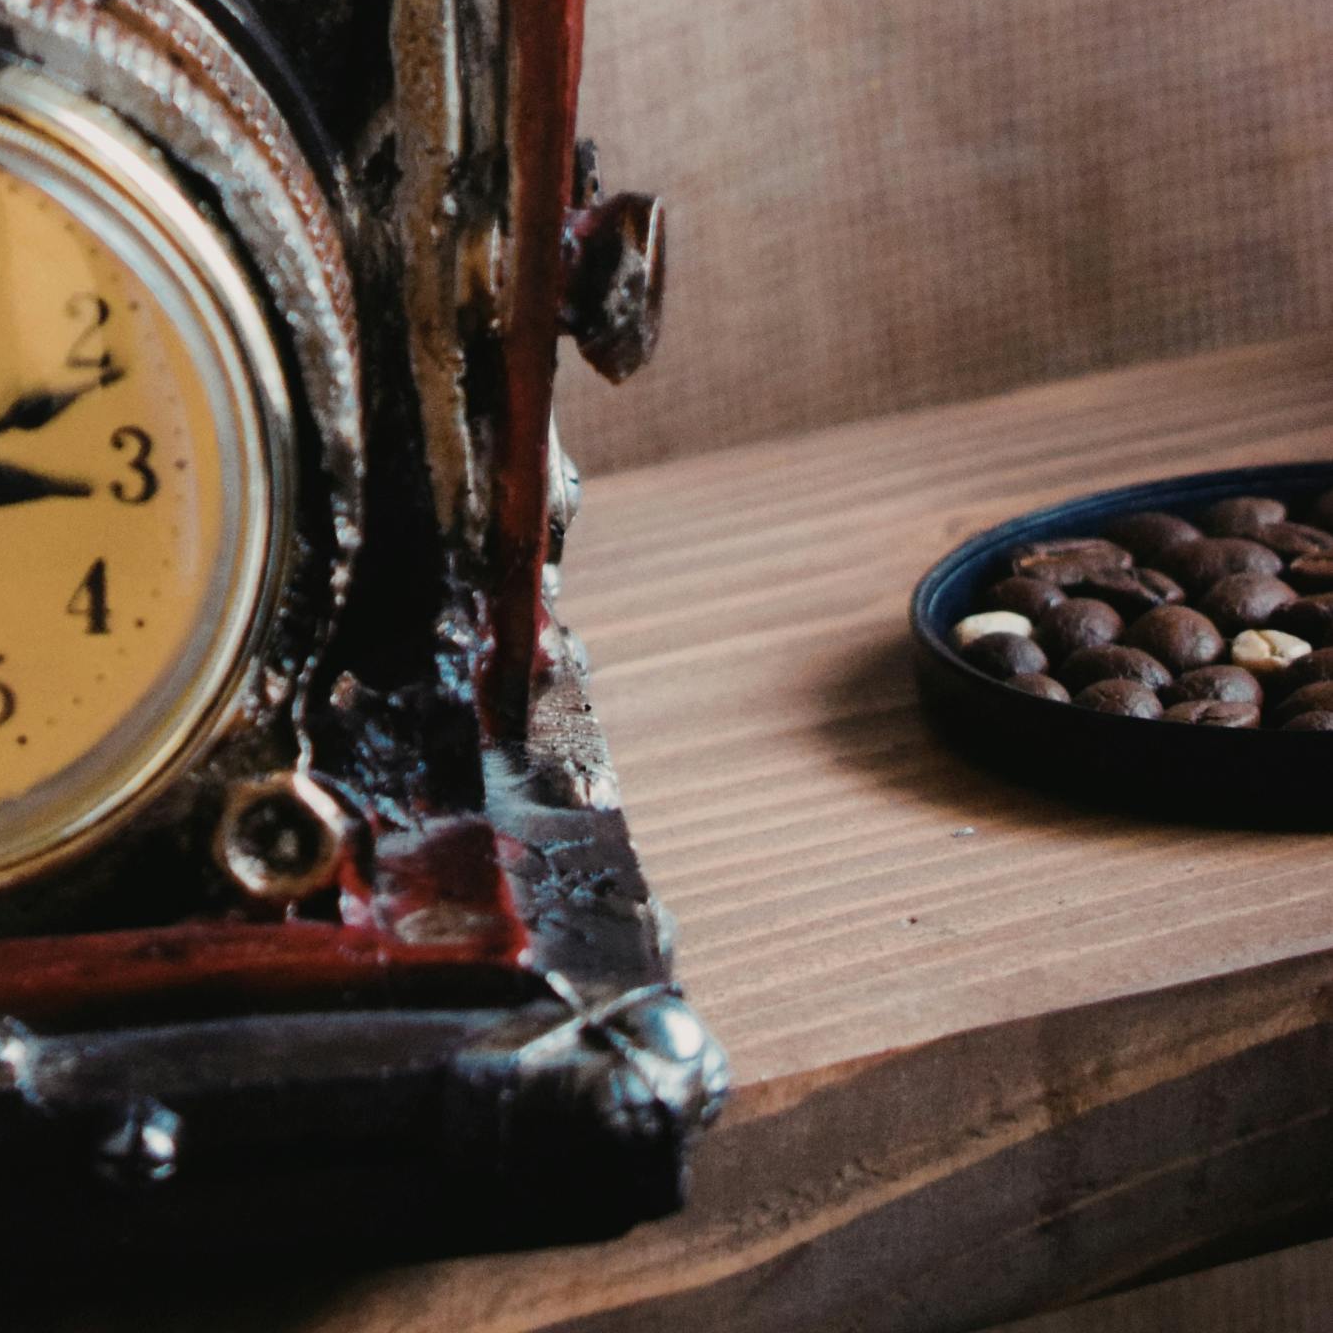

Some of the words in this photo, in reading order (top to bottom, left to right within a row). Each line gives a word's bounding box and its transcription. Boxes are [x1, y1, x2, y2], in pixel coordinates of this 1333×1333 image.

[64, 294, 113, 370] 2
[109, 427, 159, 504] 3
[66, 558, 113, 635] 4
